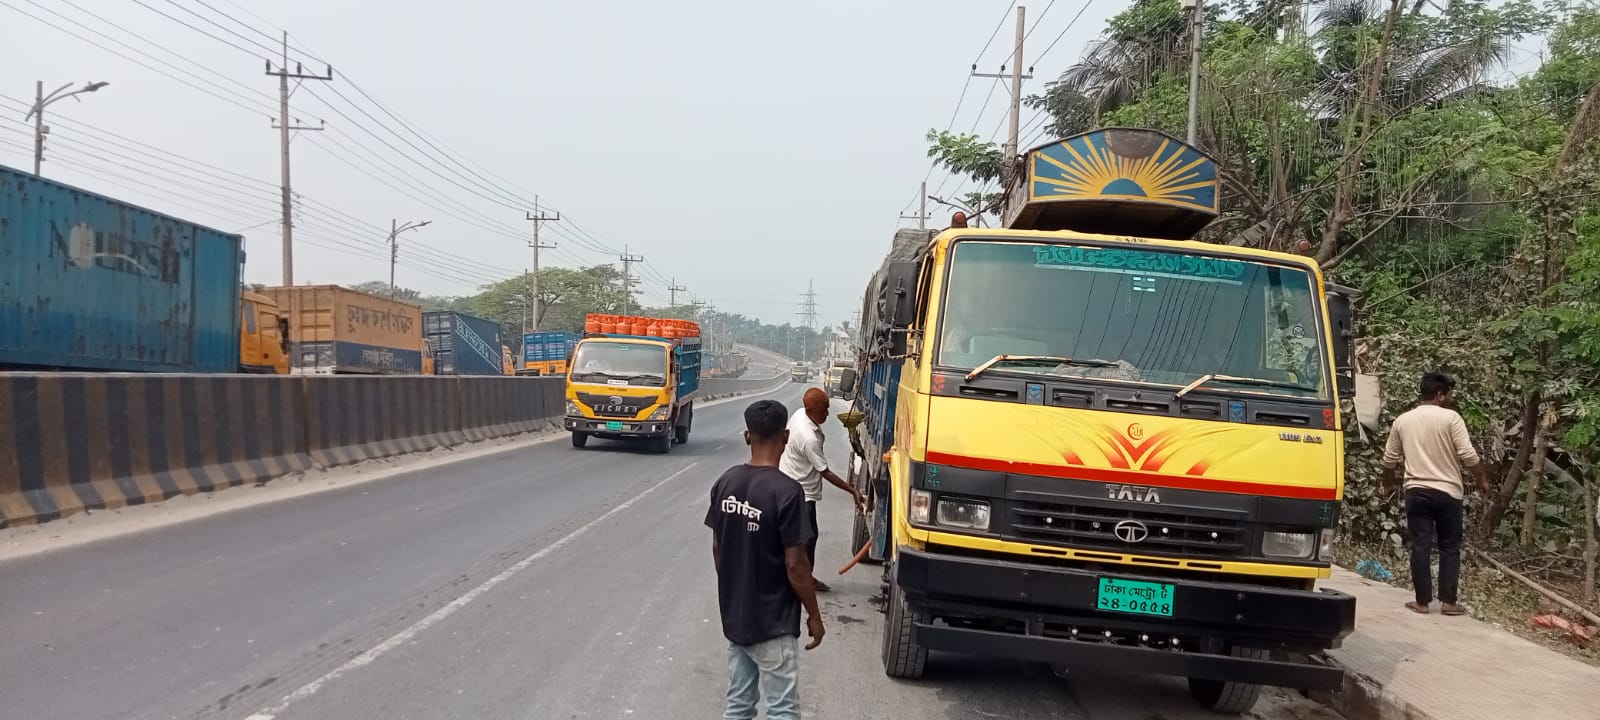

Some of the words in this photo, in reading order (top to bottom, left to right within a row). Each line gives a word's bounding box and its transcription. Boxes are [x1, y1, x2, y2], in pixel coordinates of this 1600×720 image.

[594, 404, 638, 413] EICHER
[1105, 483, 1161, 504] TATA
[1104, 583, 1126, 596] ঢাকা
[1128, 586, 1156, 600] মেট্রো
[1100, 597, 1170, 615] ২৪-০৫৫৪
